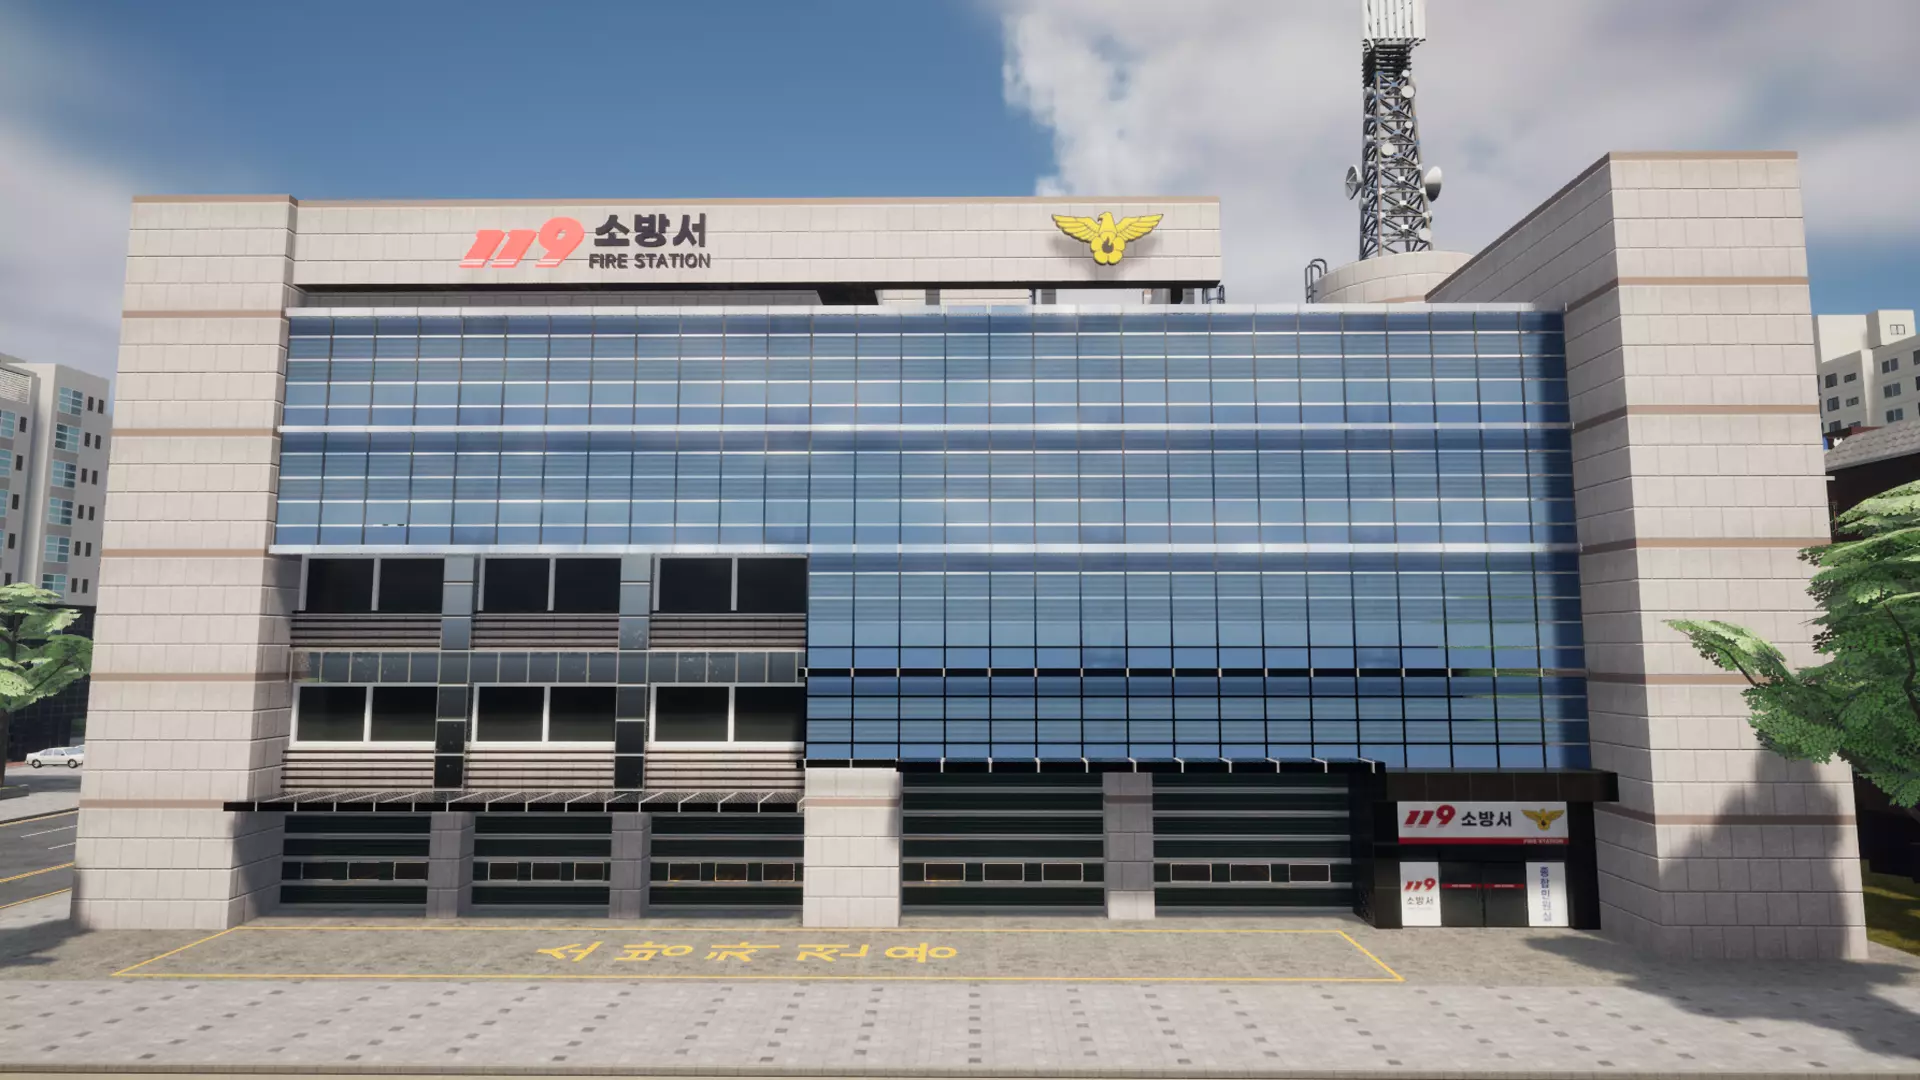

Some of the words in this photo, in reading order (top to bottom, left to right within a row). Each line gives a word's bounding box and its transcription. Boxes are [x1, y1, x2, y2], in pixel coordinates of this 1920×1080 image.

[459, 216, 586, 268] 119
[594, 213, 706, 248] 소방서
[589, 253, 628, 269] FIRE
[634, 253, 711, 269] STATION
[1404, 804, 1456, 828] 119
[1461, 810, 1513, 828] 소방서
[1404, 877, 1436, 892] 119
[1407, 896, 1434, 906] 소방서
